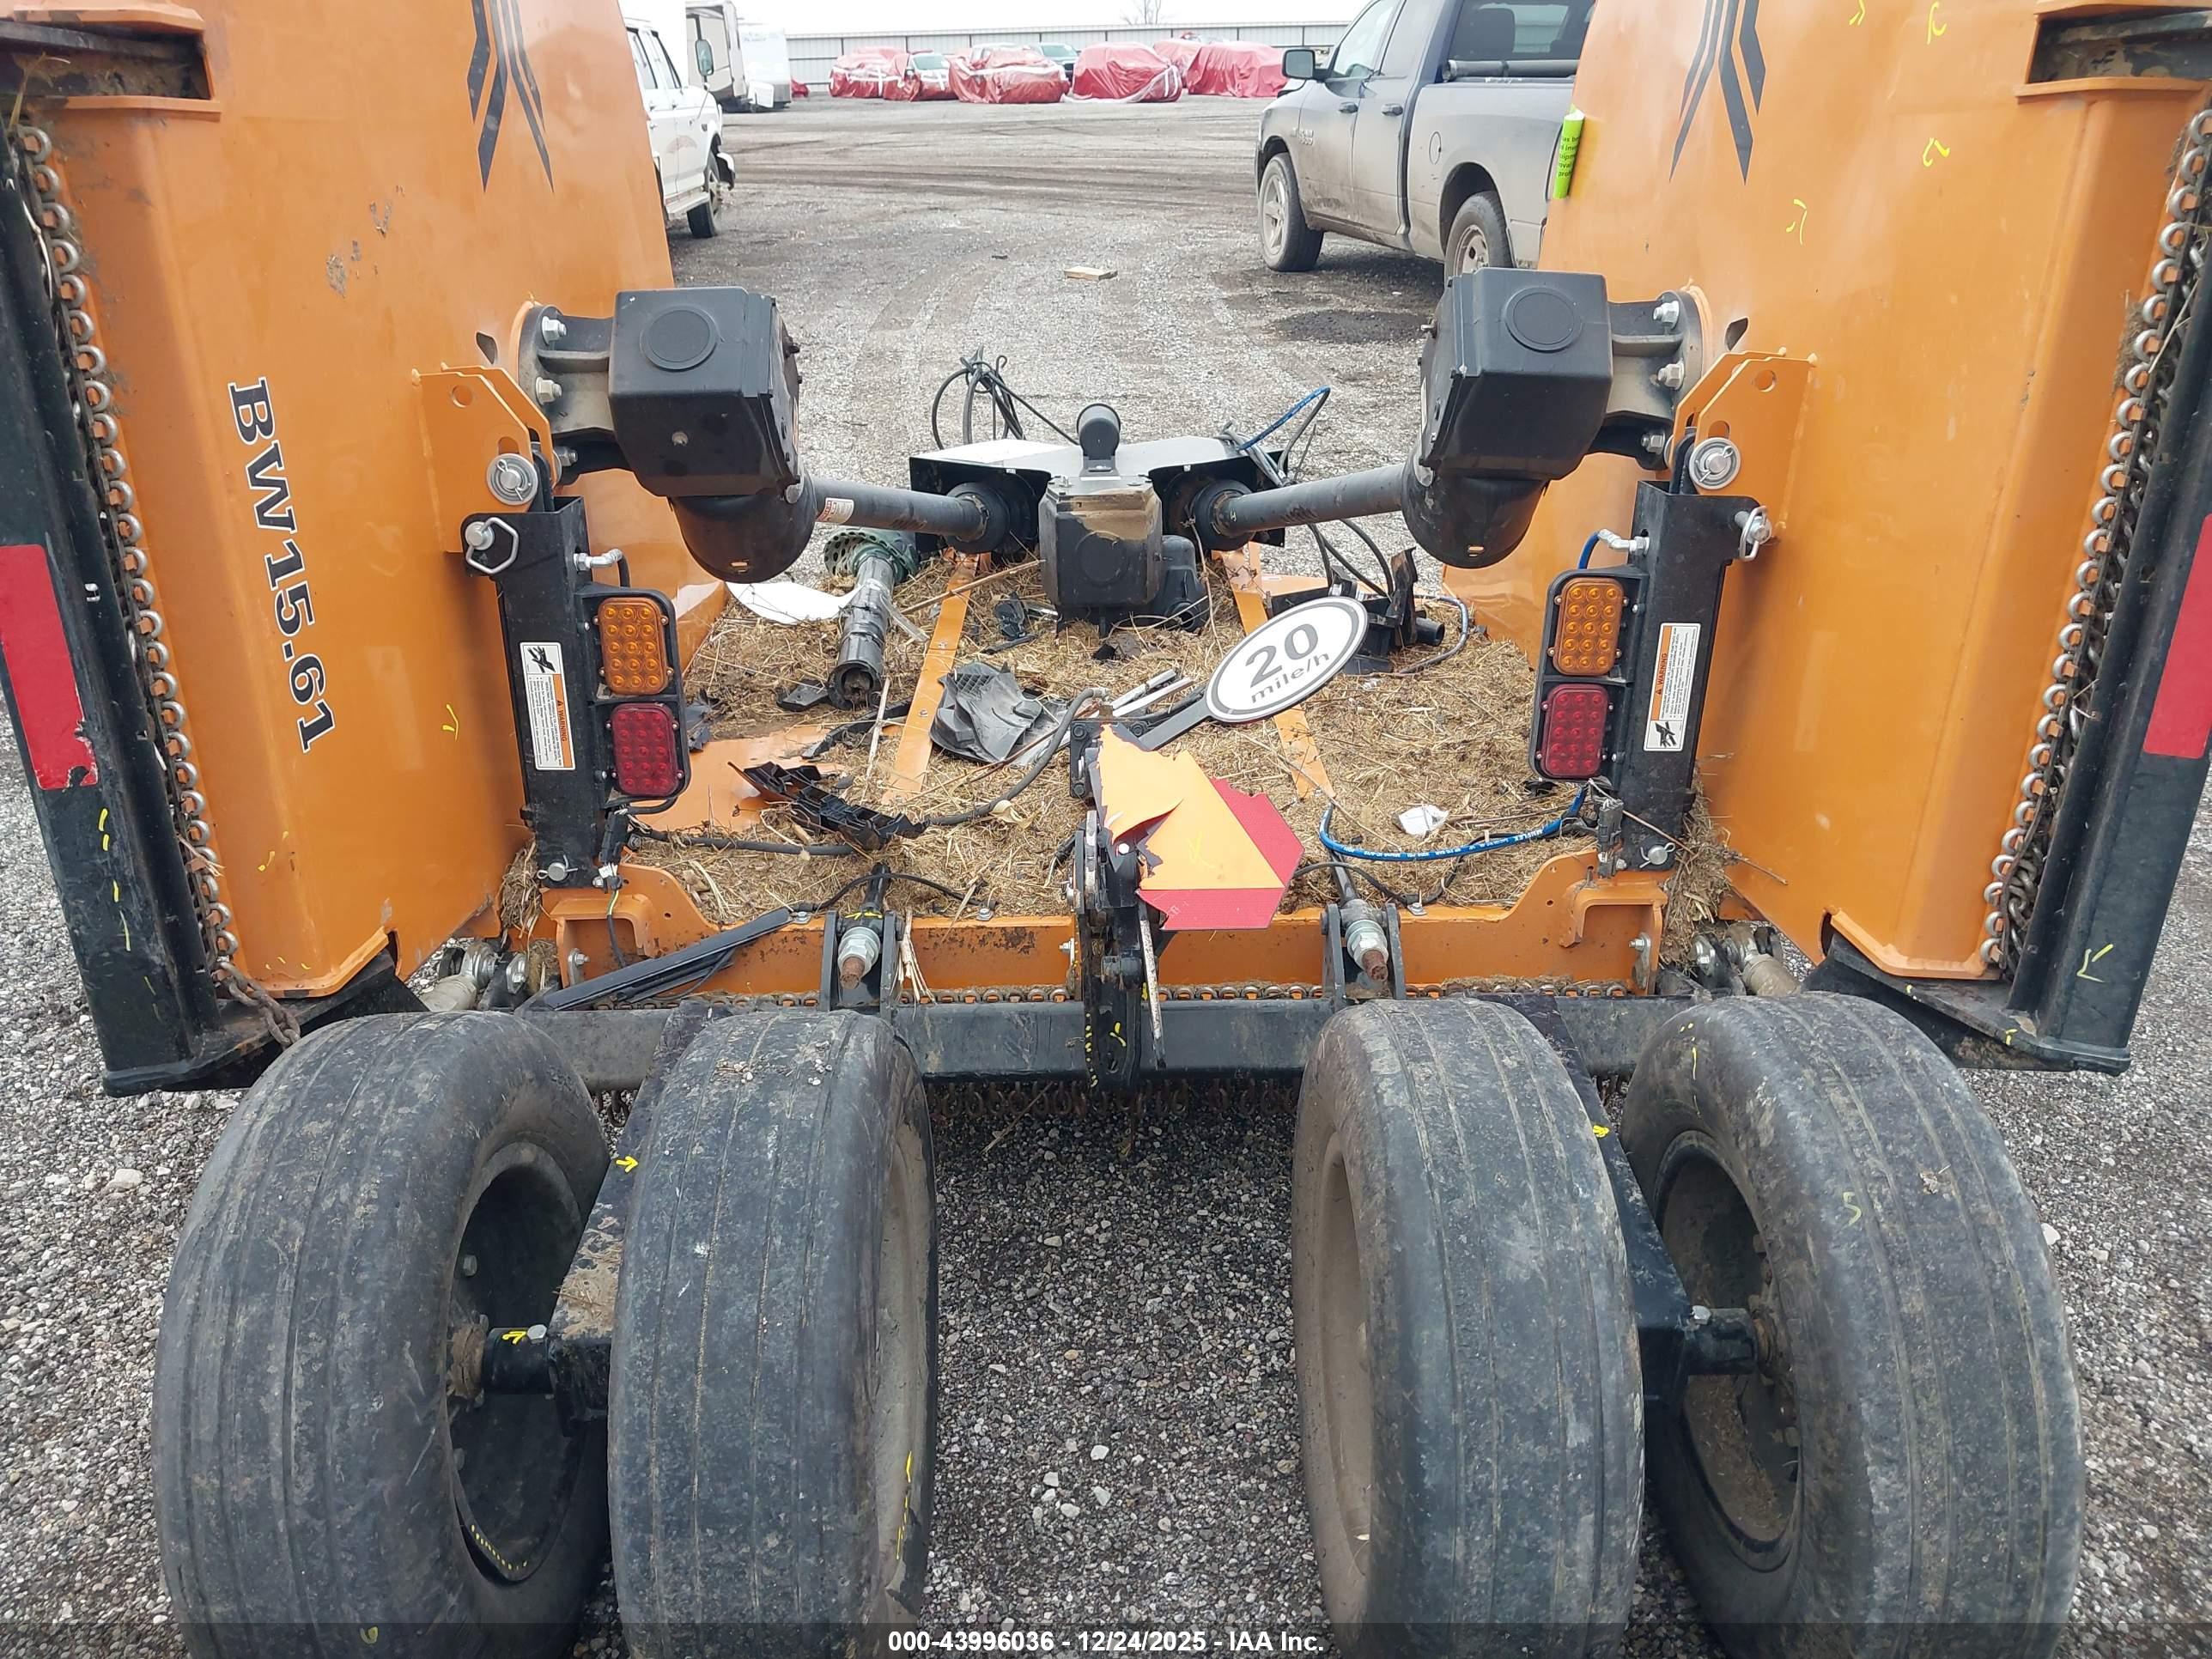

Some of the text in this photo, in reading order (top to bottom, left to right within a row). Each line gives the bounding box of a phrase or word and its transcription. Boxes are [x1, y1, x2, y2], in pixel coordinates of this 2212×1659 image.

[228, 377, 336, 753] BW15.61
[1245, 623, 1319, 688] 20
[1251, 652, 1330, 703] mile/h
[1657, 653, 1668, 685] WARNING
[558, 709, 568, 742] WARNING
